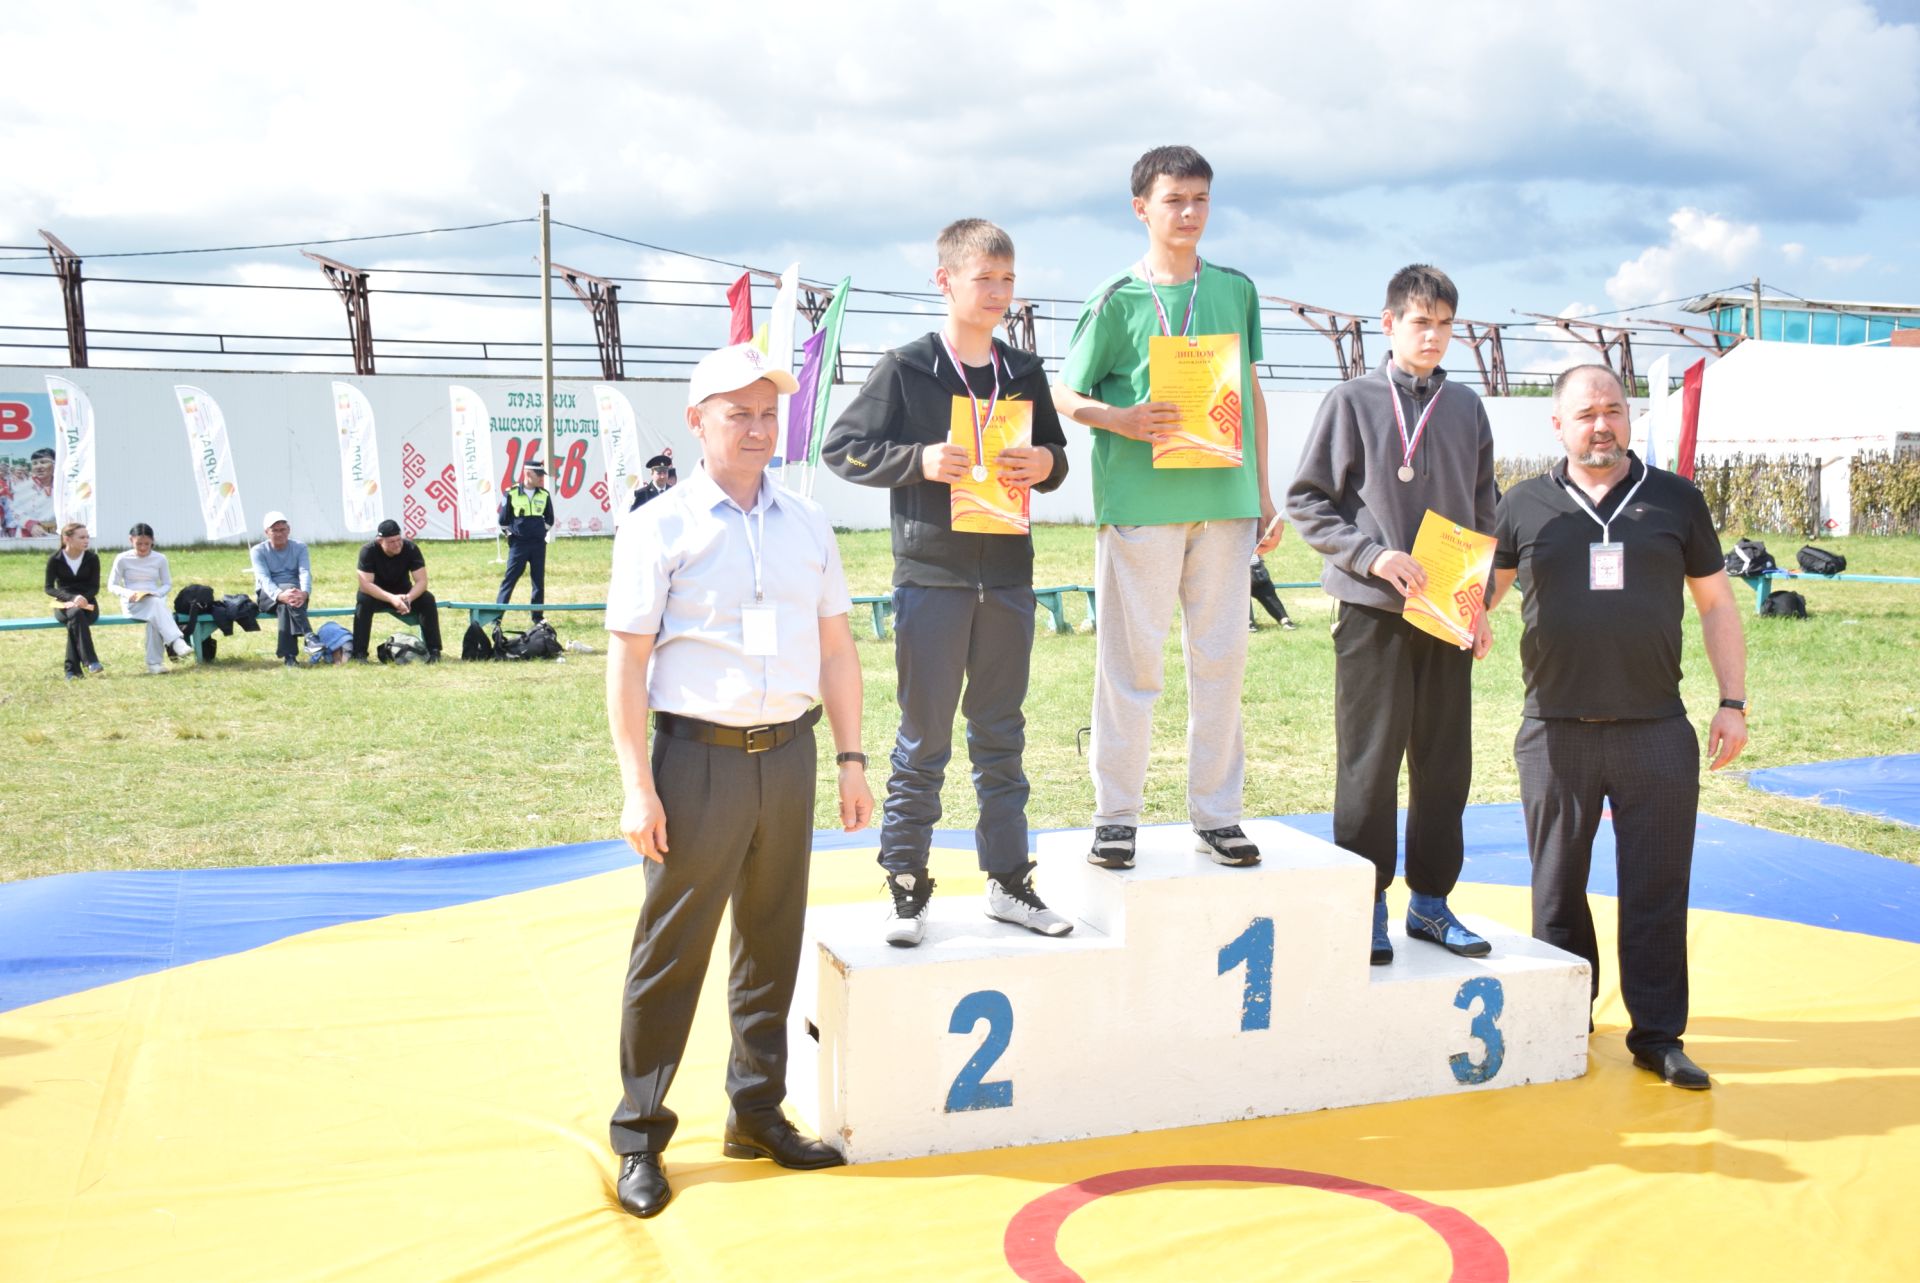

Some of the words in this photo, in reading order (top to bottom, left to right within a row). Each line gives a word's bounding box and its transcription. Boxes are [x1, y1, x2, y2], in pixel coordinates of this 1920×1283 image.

[490, 416, 543, 433] АШСКОЙ
[508, 392, 576, 409] ПРАЗНИК
[1218, 917, 1274, 1031] 1
[945, 990, 1013, 1112] 2
[1450, 977, 1504, 1084] 3
